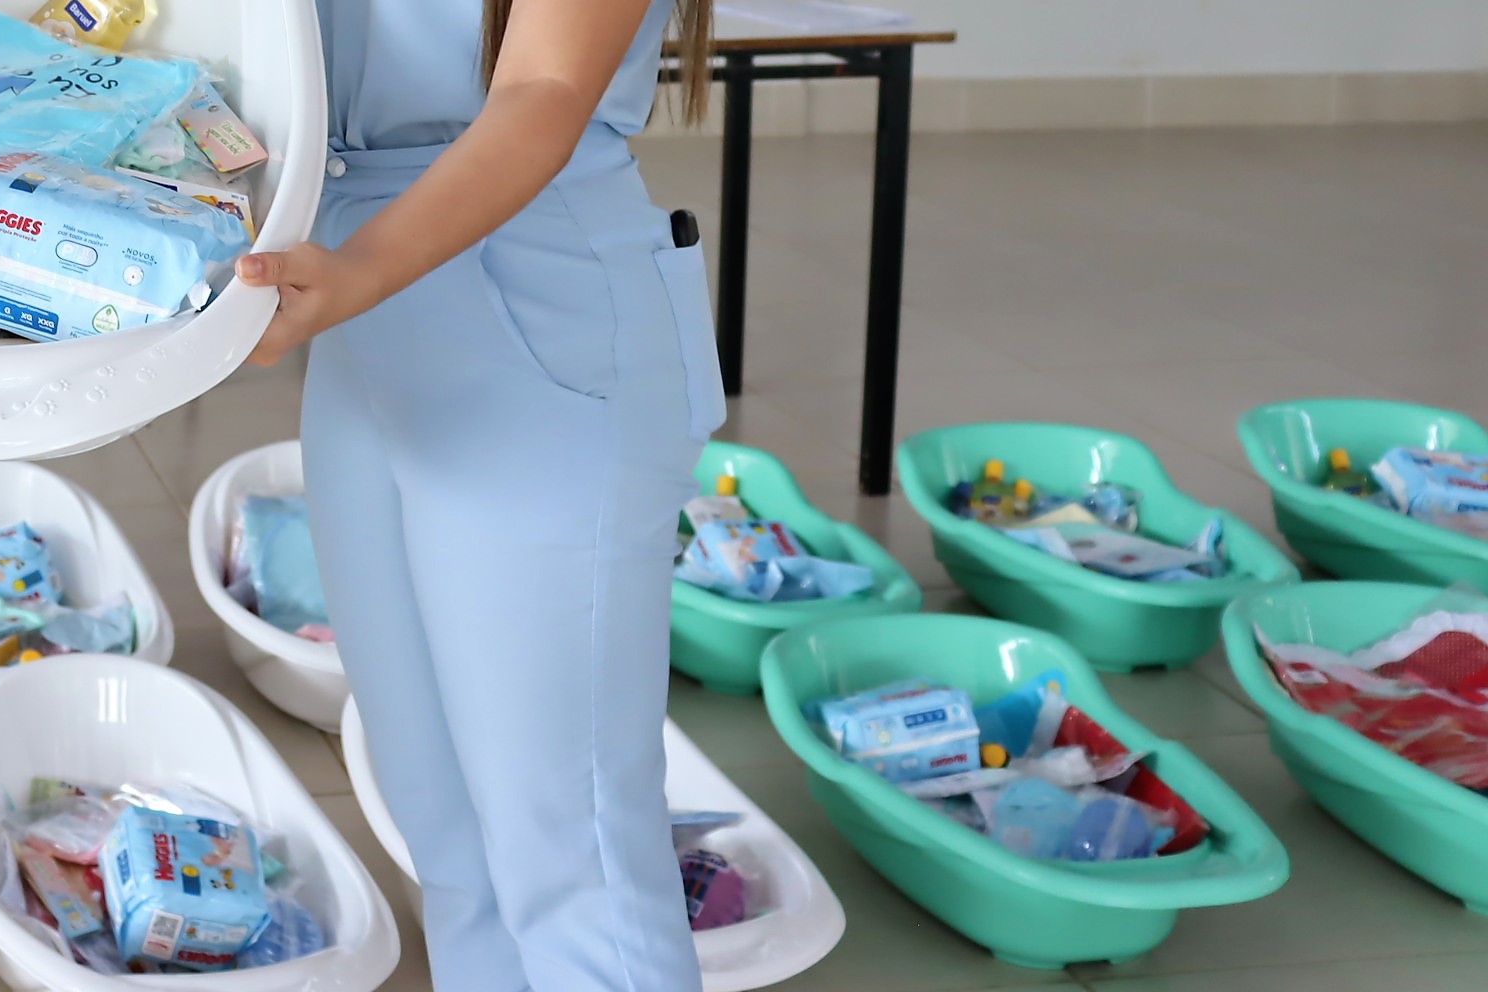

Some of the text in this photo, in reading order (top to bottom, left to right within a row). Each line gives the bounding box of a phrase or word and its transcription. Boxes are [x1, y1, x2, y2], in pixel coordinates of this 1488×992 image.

[69, 2, 93, 28] Baruel
[126, 247, 155, 262] NOVOS
[153, 832, 175, 882] HUGGIES
